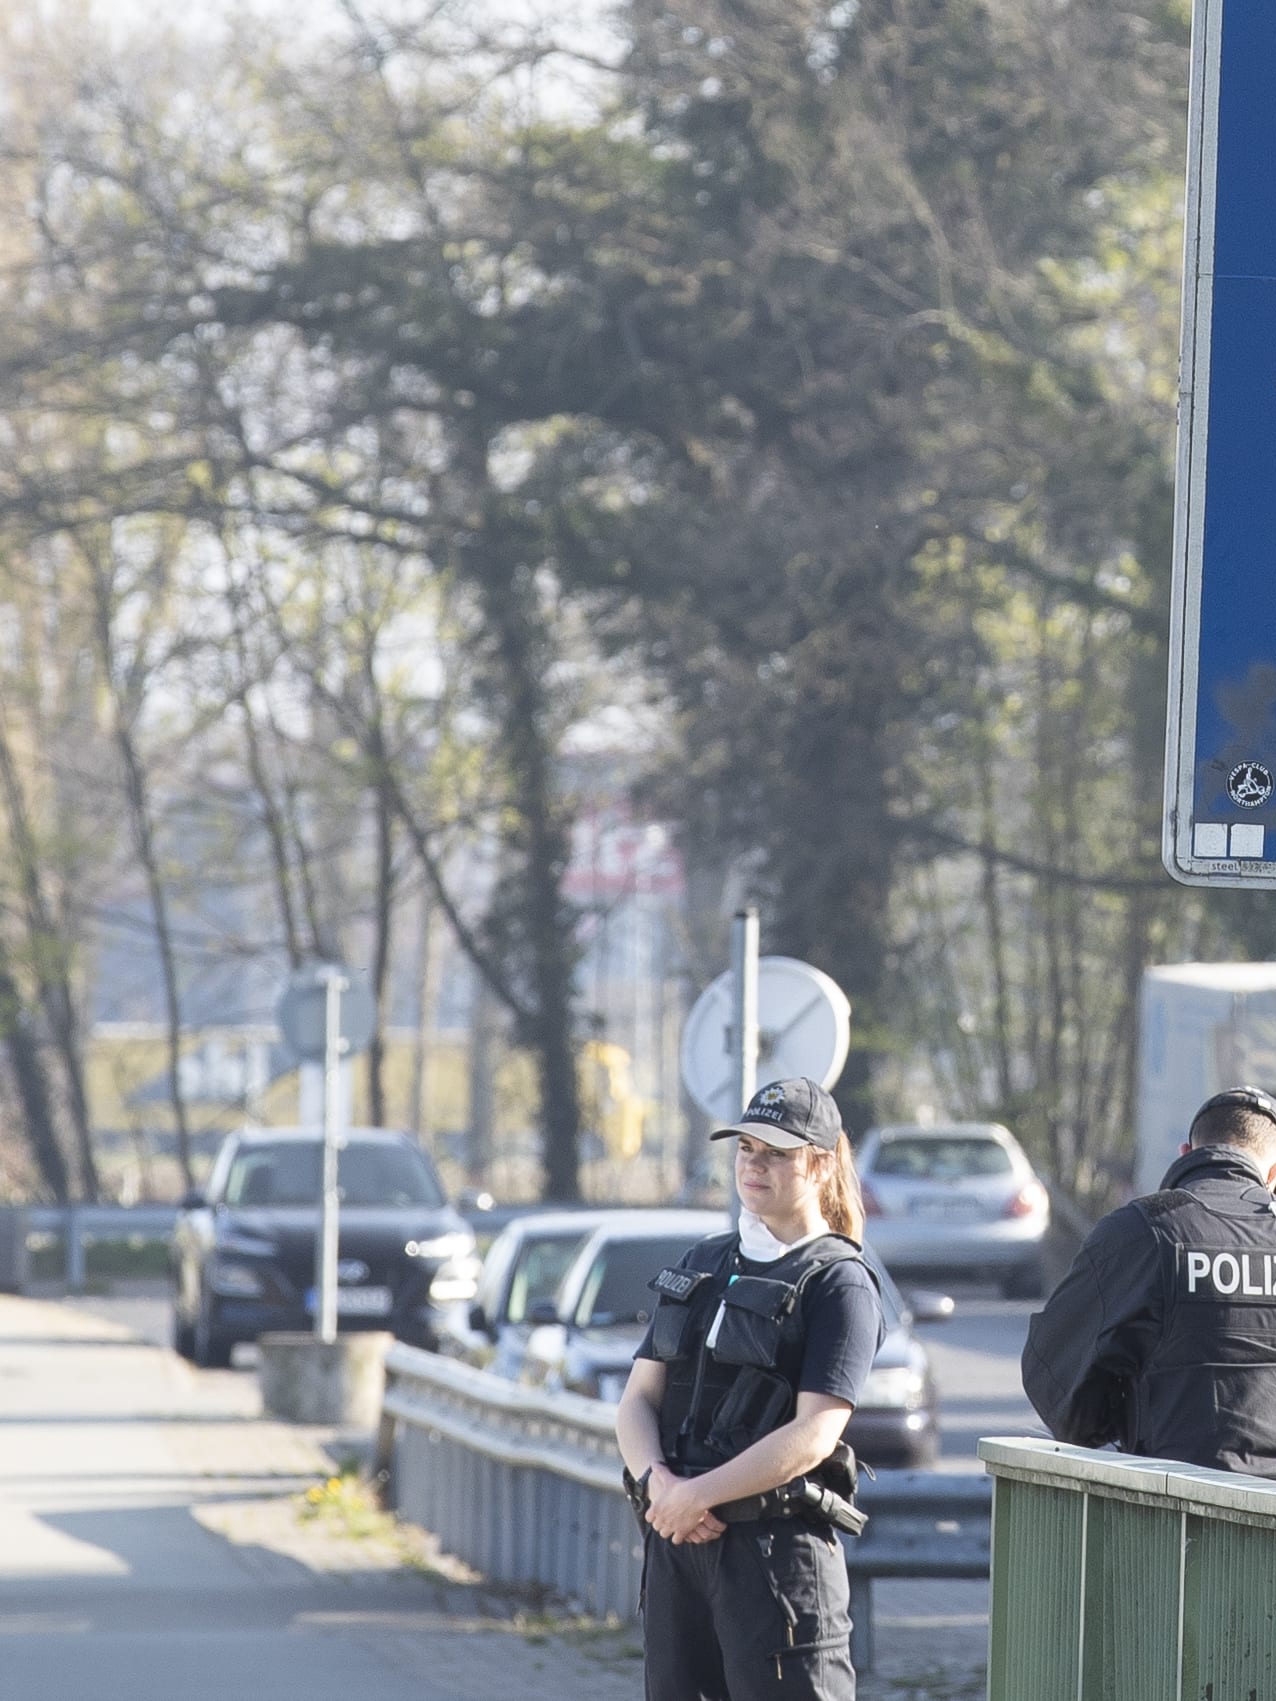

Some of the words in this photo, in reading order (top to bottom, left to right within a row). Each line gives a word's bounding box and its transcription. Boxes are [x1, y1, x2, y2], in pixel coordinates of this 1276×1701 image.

[1251, 762, 1269, 776] CLUB
[1230, 785, 1272, 807] NORTHAMPTON
[1211, 862, 1239, 871] steel
